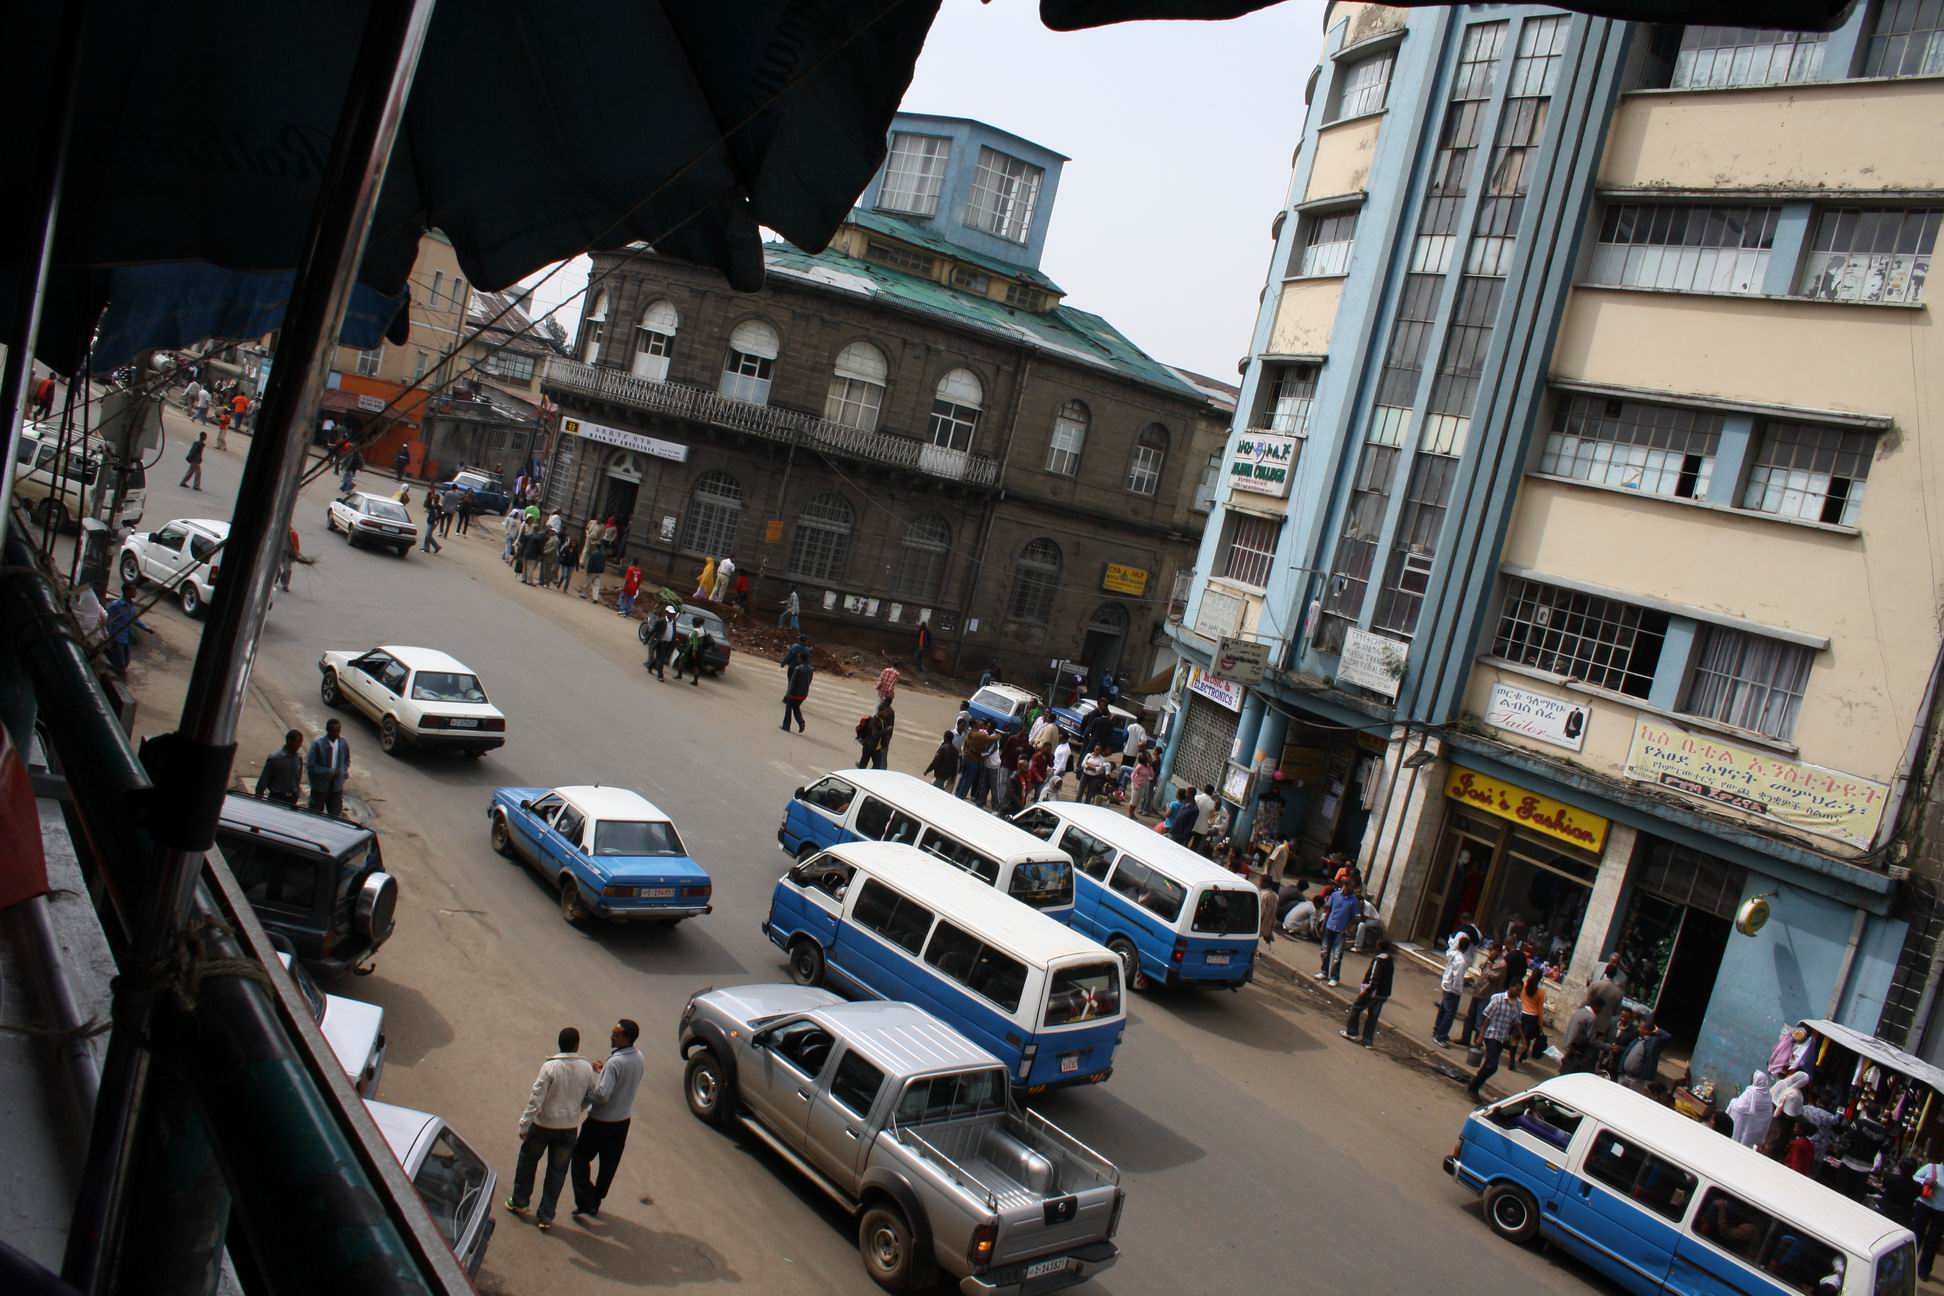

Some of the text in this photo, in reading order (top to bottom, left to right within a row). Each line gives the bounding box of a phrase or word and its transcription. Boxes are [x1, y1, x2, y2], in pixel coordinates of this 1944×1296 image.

[589, 432, 606, 441] BANK
[1254, 464, 1287, 484] COLLEGE
[1194, 680, 1233, 706] ELECTRONICS
[1224, 681, 1231, 692] &
[1487, 709, 1547, 736] Tailor
[1515, 796, 1596, 844] Fashion
